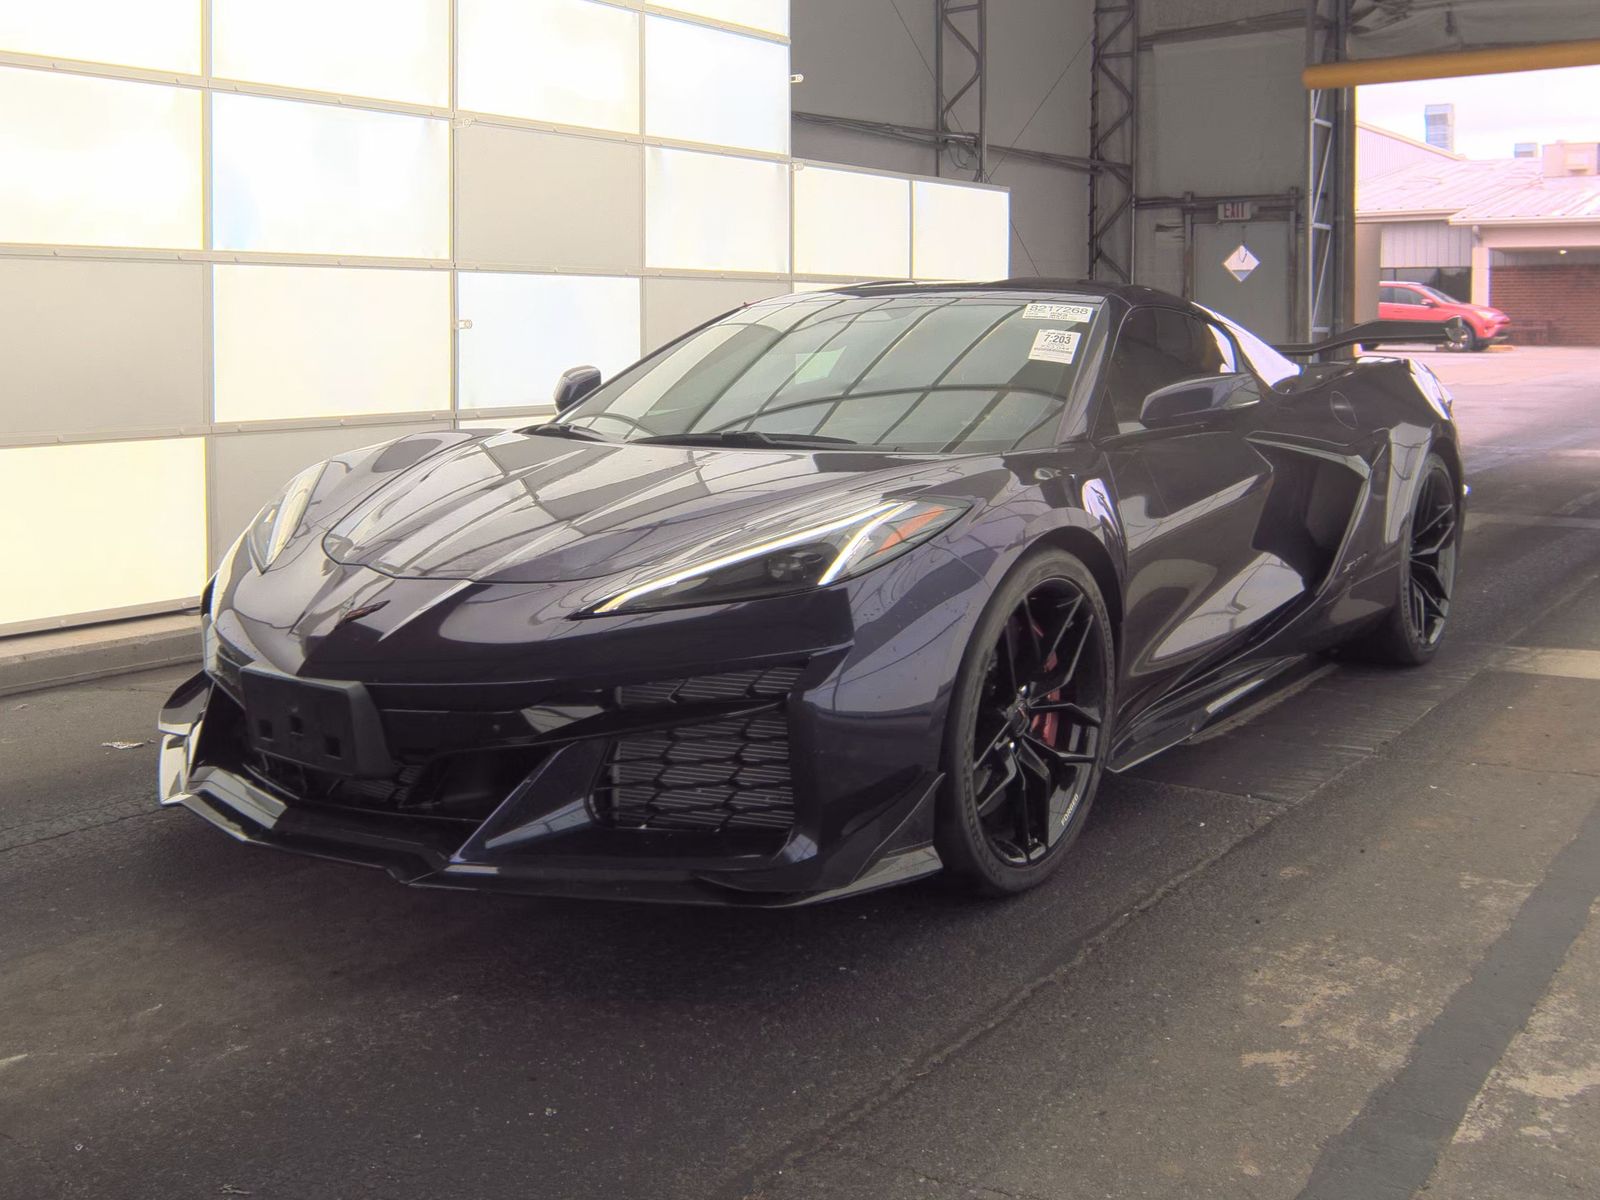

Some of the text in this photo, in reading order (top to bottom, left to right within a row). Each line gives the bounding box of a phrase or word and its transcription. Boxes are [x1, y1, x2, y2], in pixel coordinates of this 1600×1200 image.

[1223, 202, 1247, 219] EXIT
[1029, 304, 1089, 315] 8217268
[1060, 793, 1079, 826] FORGED
